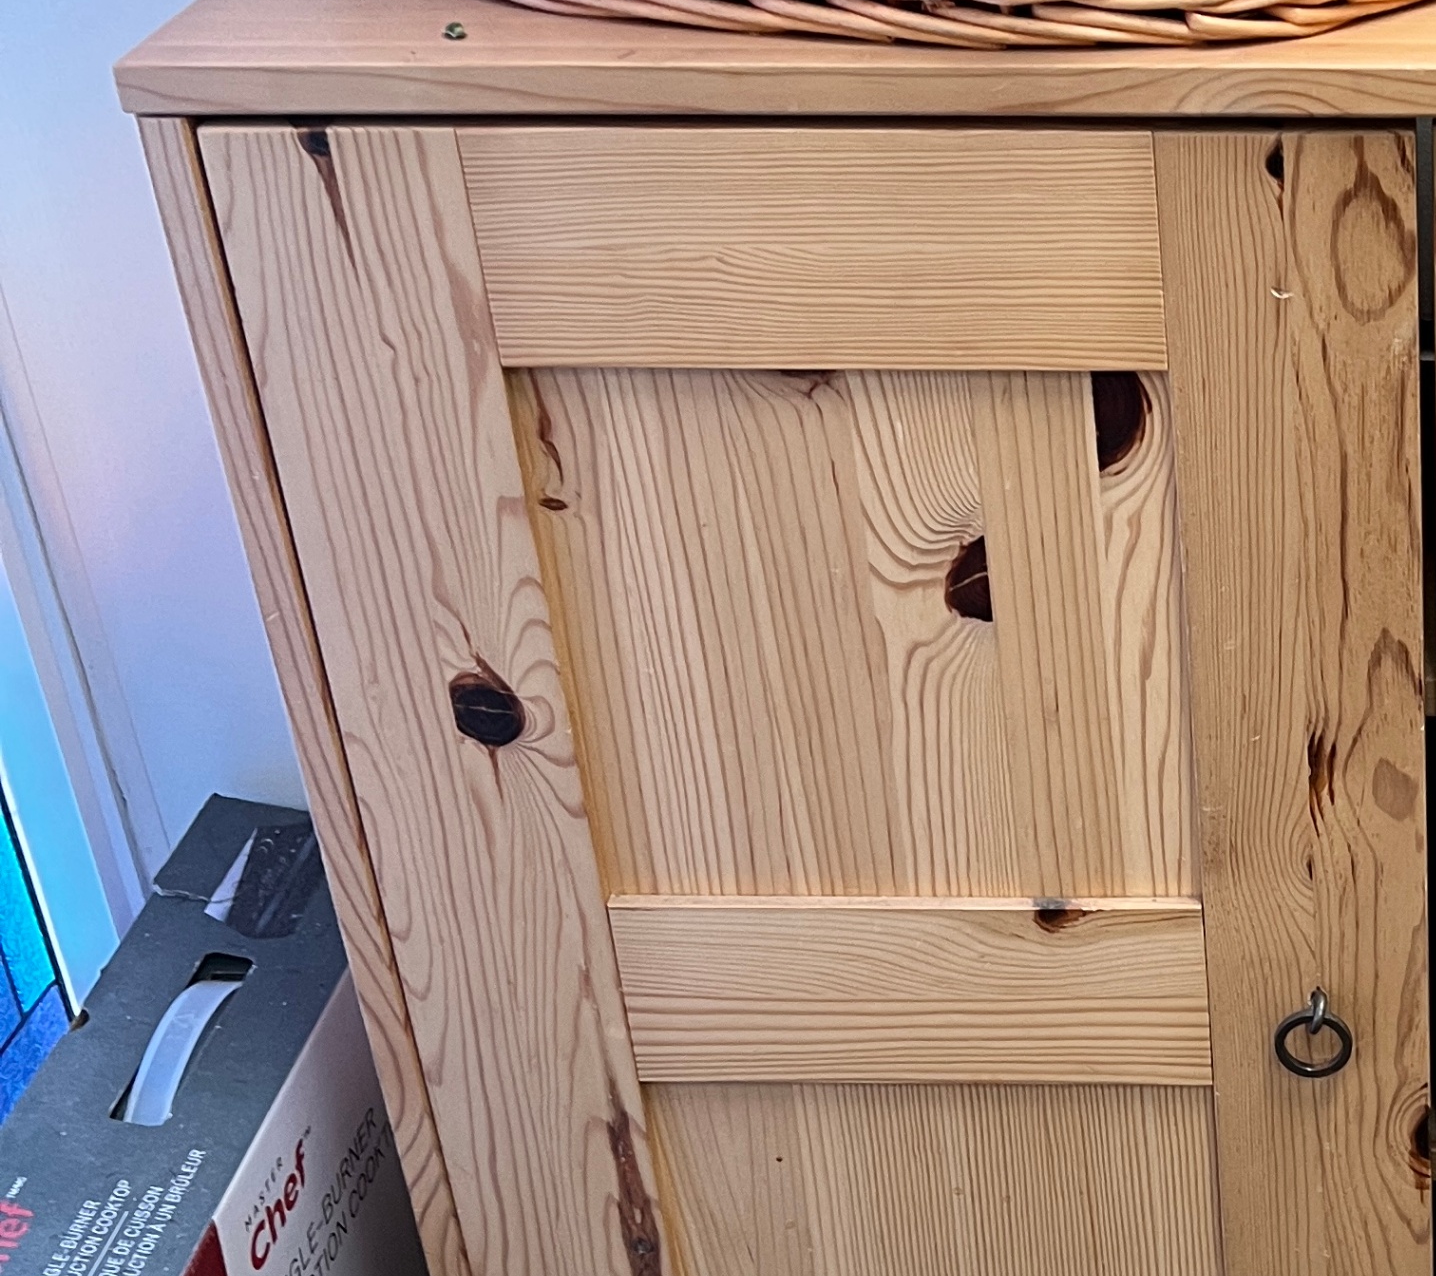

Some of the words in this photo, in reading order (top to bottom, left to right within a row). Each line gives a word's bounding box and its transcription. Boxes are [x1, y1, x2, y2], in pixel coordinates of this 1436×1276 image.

[164, 1148, 206, 1204] BRÛLEUR
[92, 1179, 132, 1235] COOKTOP
[123, 1185, 165, 1238] CUISSON
[154, 1204, 177, 1222] UN
[250, 1138, 306, 1271] Chef
[112, 1239, 135, 1255] DE
